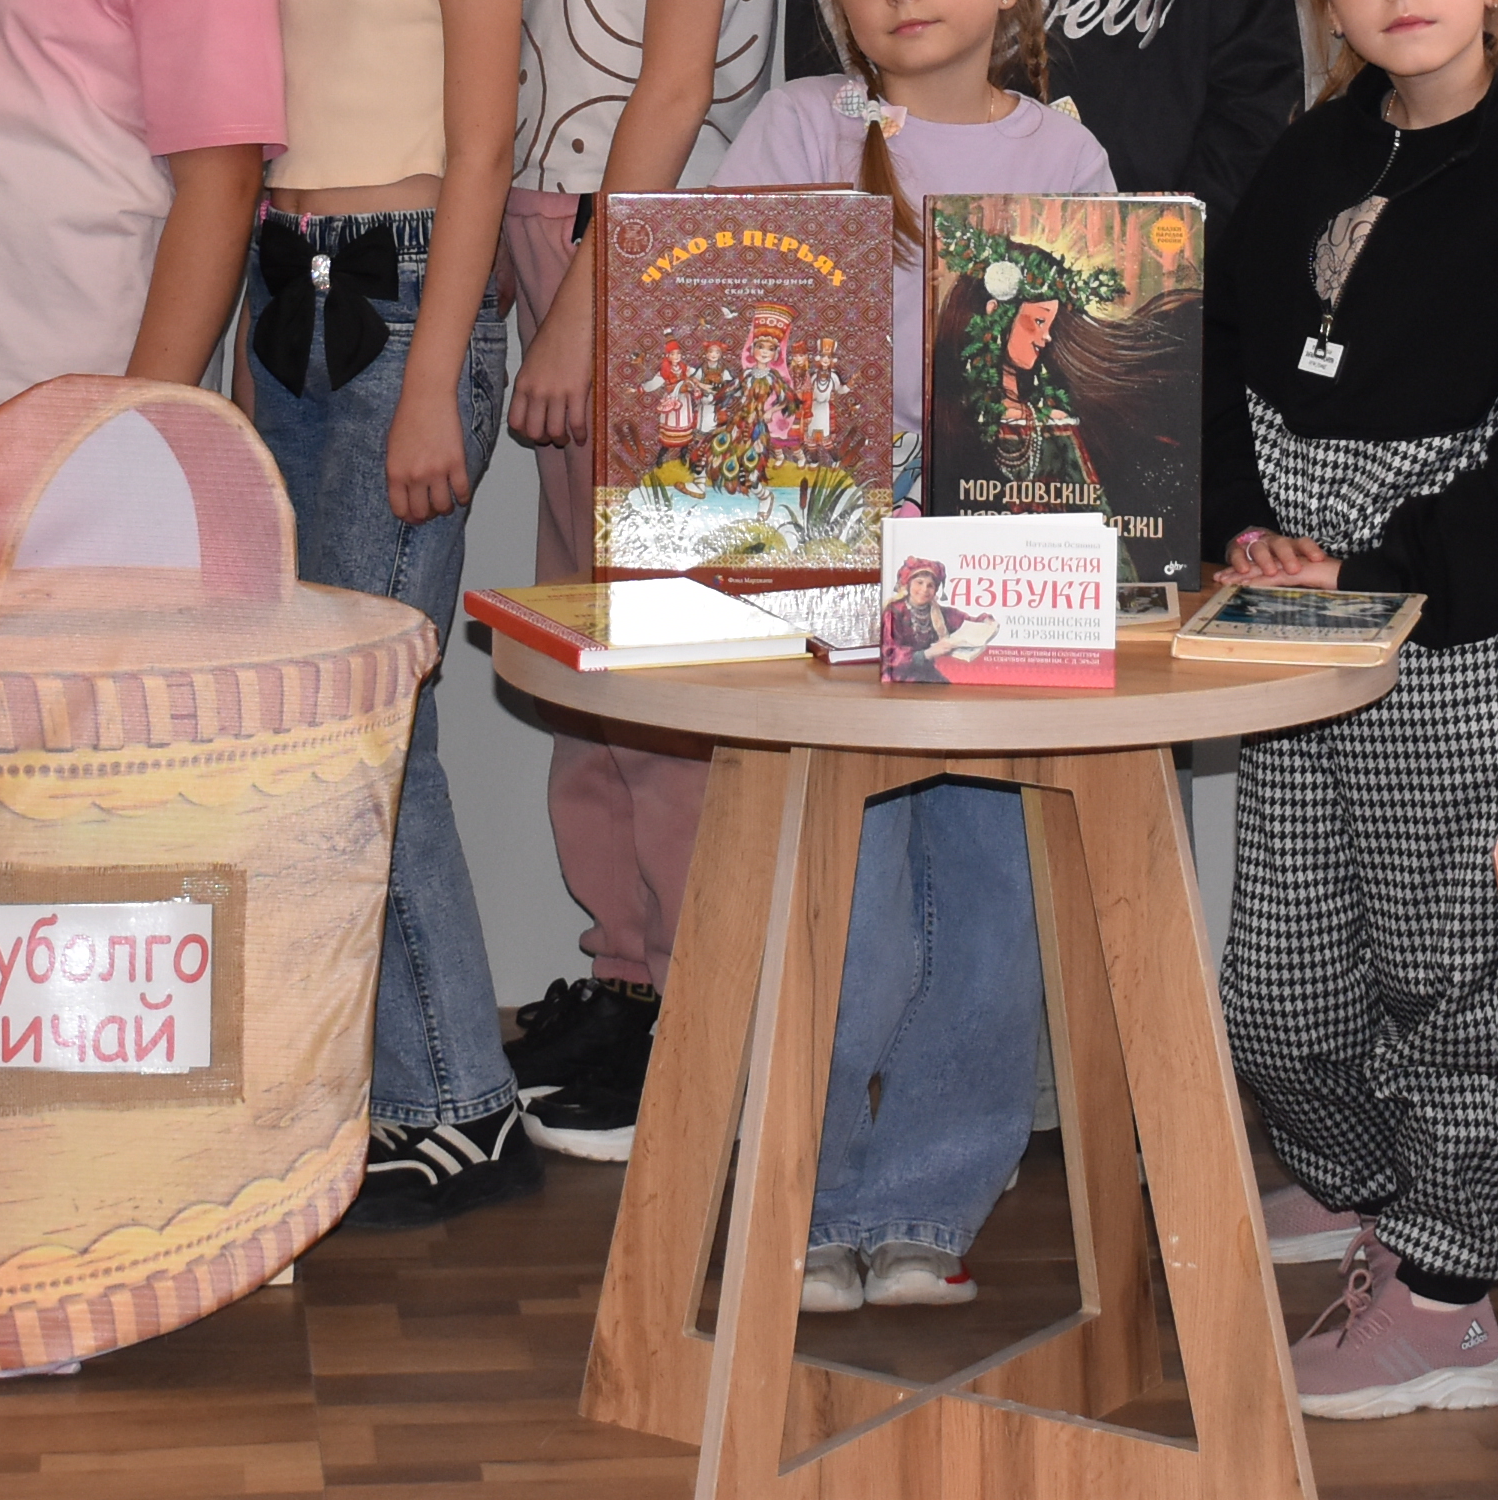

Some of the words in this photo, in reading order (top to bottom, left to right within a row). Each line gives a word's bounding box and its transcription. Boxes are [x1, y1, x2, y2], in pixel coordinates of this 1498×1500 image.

[641, 237, 708, 283] ЧУДО
[715, 231, 735, 248] В
[743, 230, 847, 287] ПЕРЬЯХ
[675, 276, 748, 286] Мордовские
[753, 277, 814, 286] народные
[724, 287, 765, 296] сказки
[959, 479, 1102, 506] МОРДОВСКИЕ
[959, 553, 1101, 574] МОРДОВСКАЯ
[949, 577, 1100, 610] АЗБУКА
[1006, 615, 1101, 628] МОКШАНСКАЯ
[1010, 628, 1019, 639] И
[1023, 628, 1101, 641] ЭРЗЯНСКАЯ
